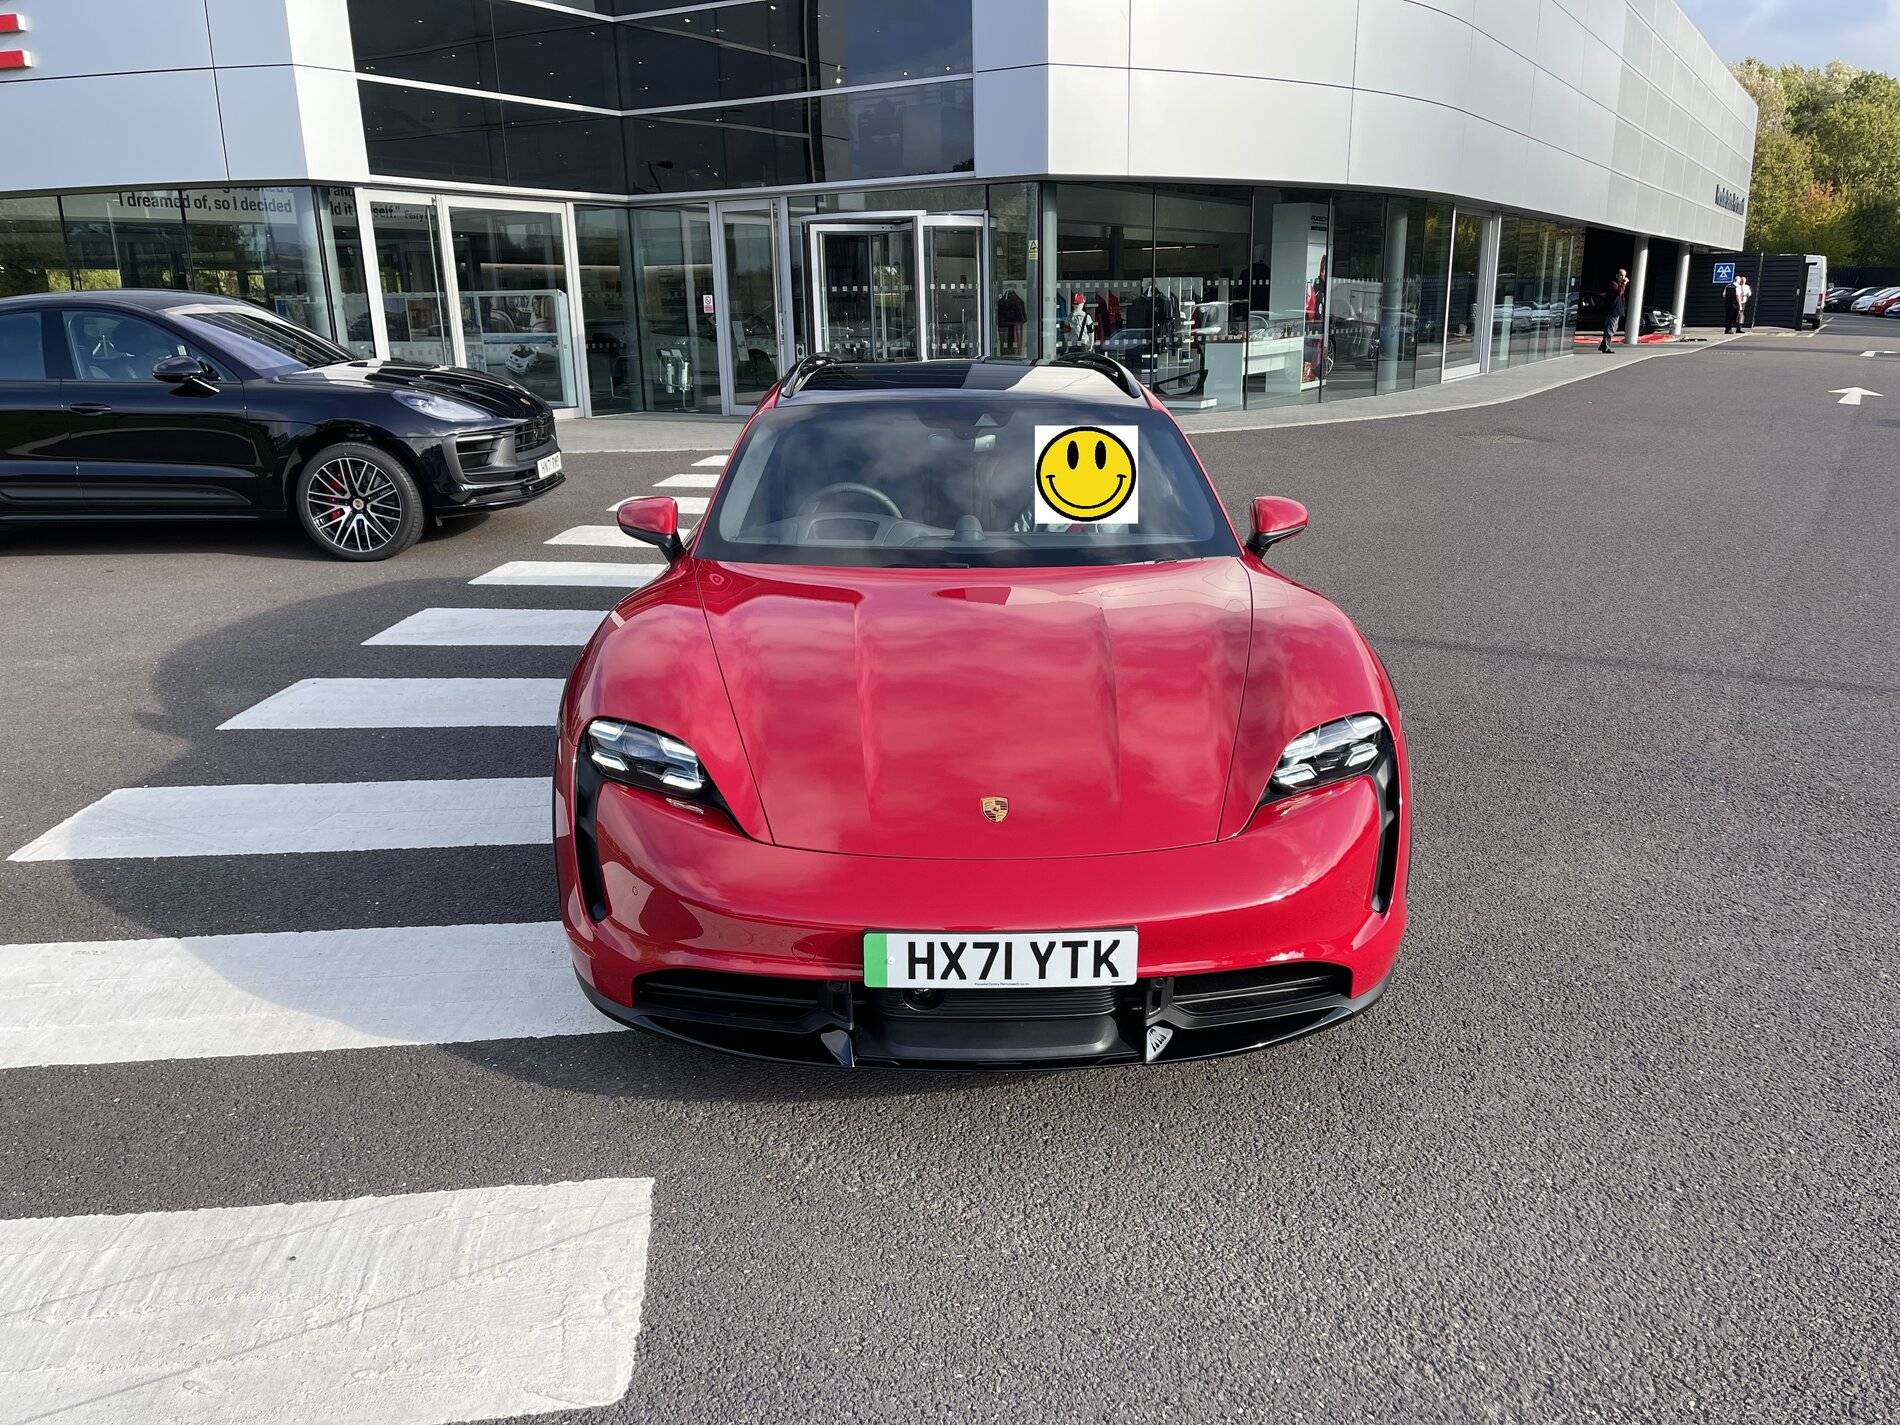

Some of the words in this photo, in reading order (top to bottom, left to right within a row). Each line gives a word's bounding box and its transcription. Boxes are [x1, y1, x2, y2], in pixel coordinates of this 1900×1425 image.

[127, 192, 191, 209] dreamed
[194, 195, 212, 212] of,
[214, 199, 230, 210] so
[241, 197, 292, 213] decided
[907, 941, 1013, 980] HX71
[1029, 939, 1121, 979] YTK
